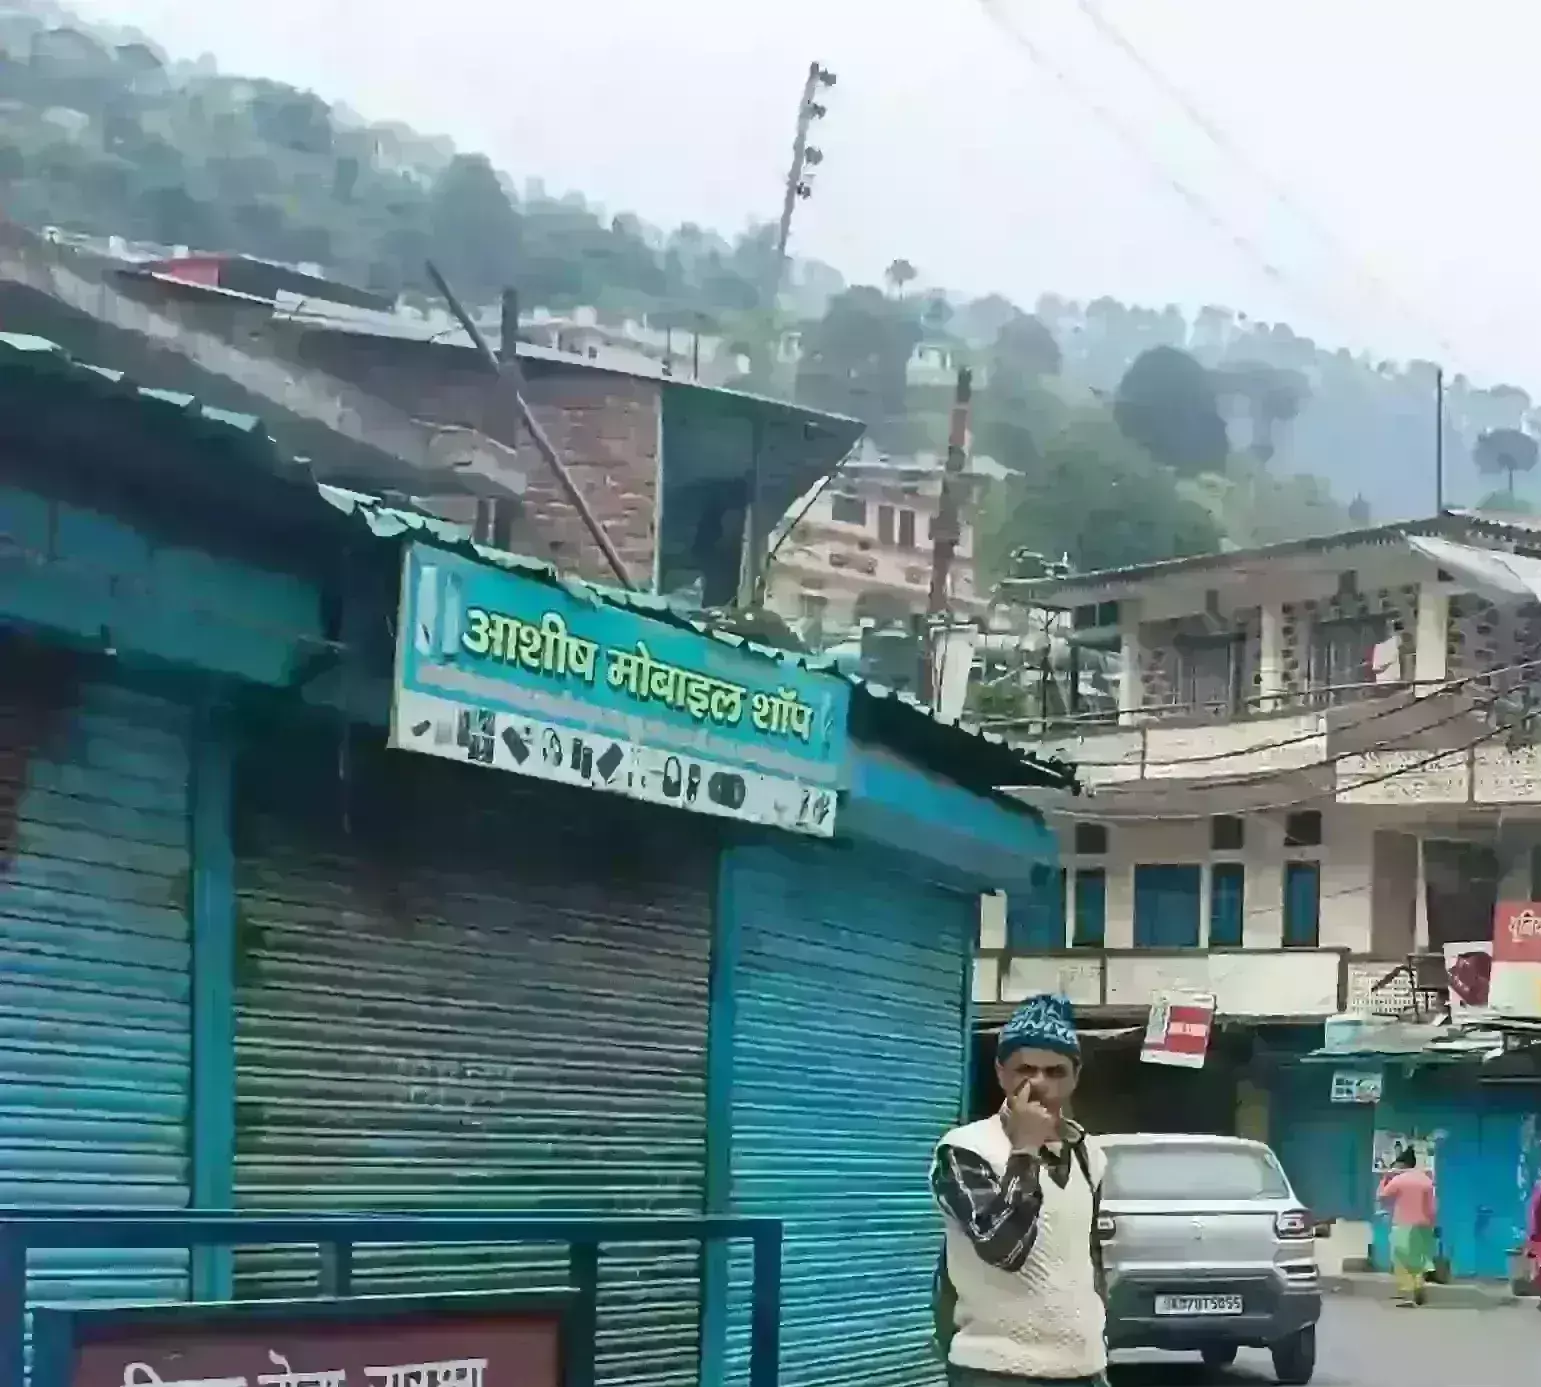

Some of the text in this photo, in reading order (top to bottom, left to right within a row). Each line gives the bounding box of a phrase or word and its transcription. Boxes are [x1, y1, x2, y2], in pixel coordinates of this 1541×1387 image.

[461, 608, 815, 741] आशीष मोबाइल शॉप
